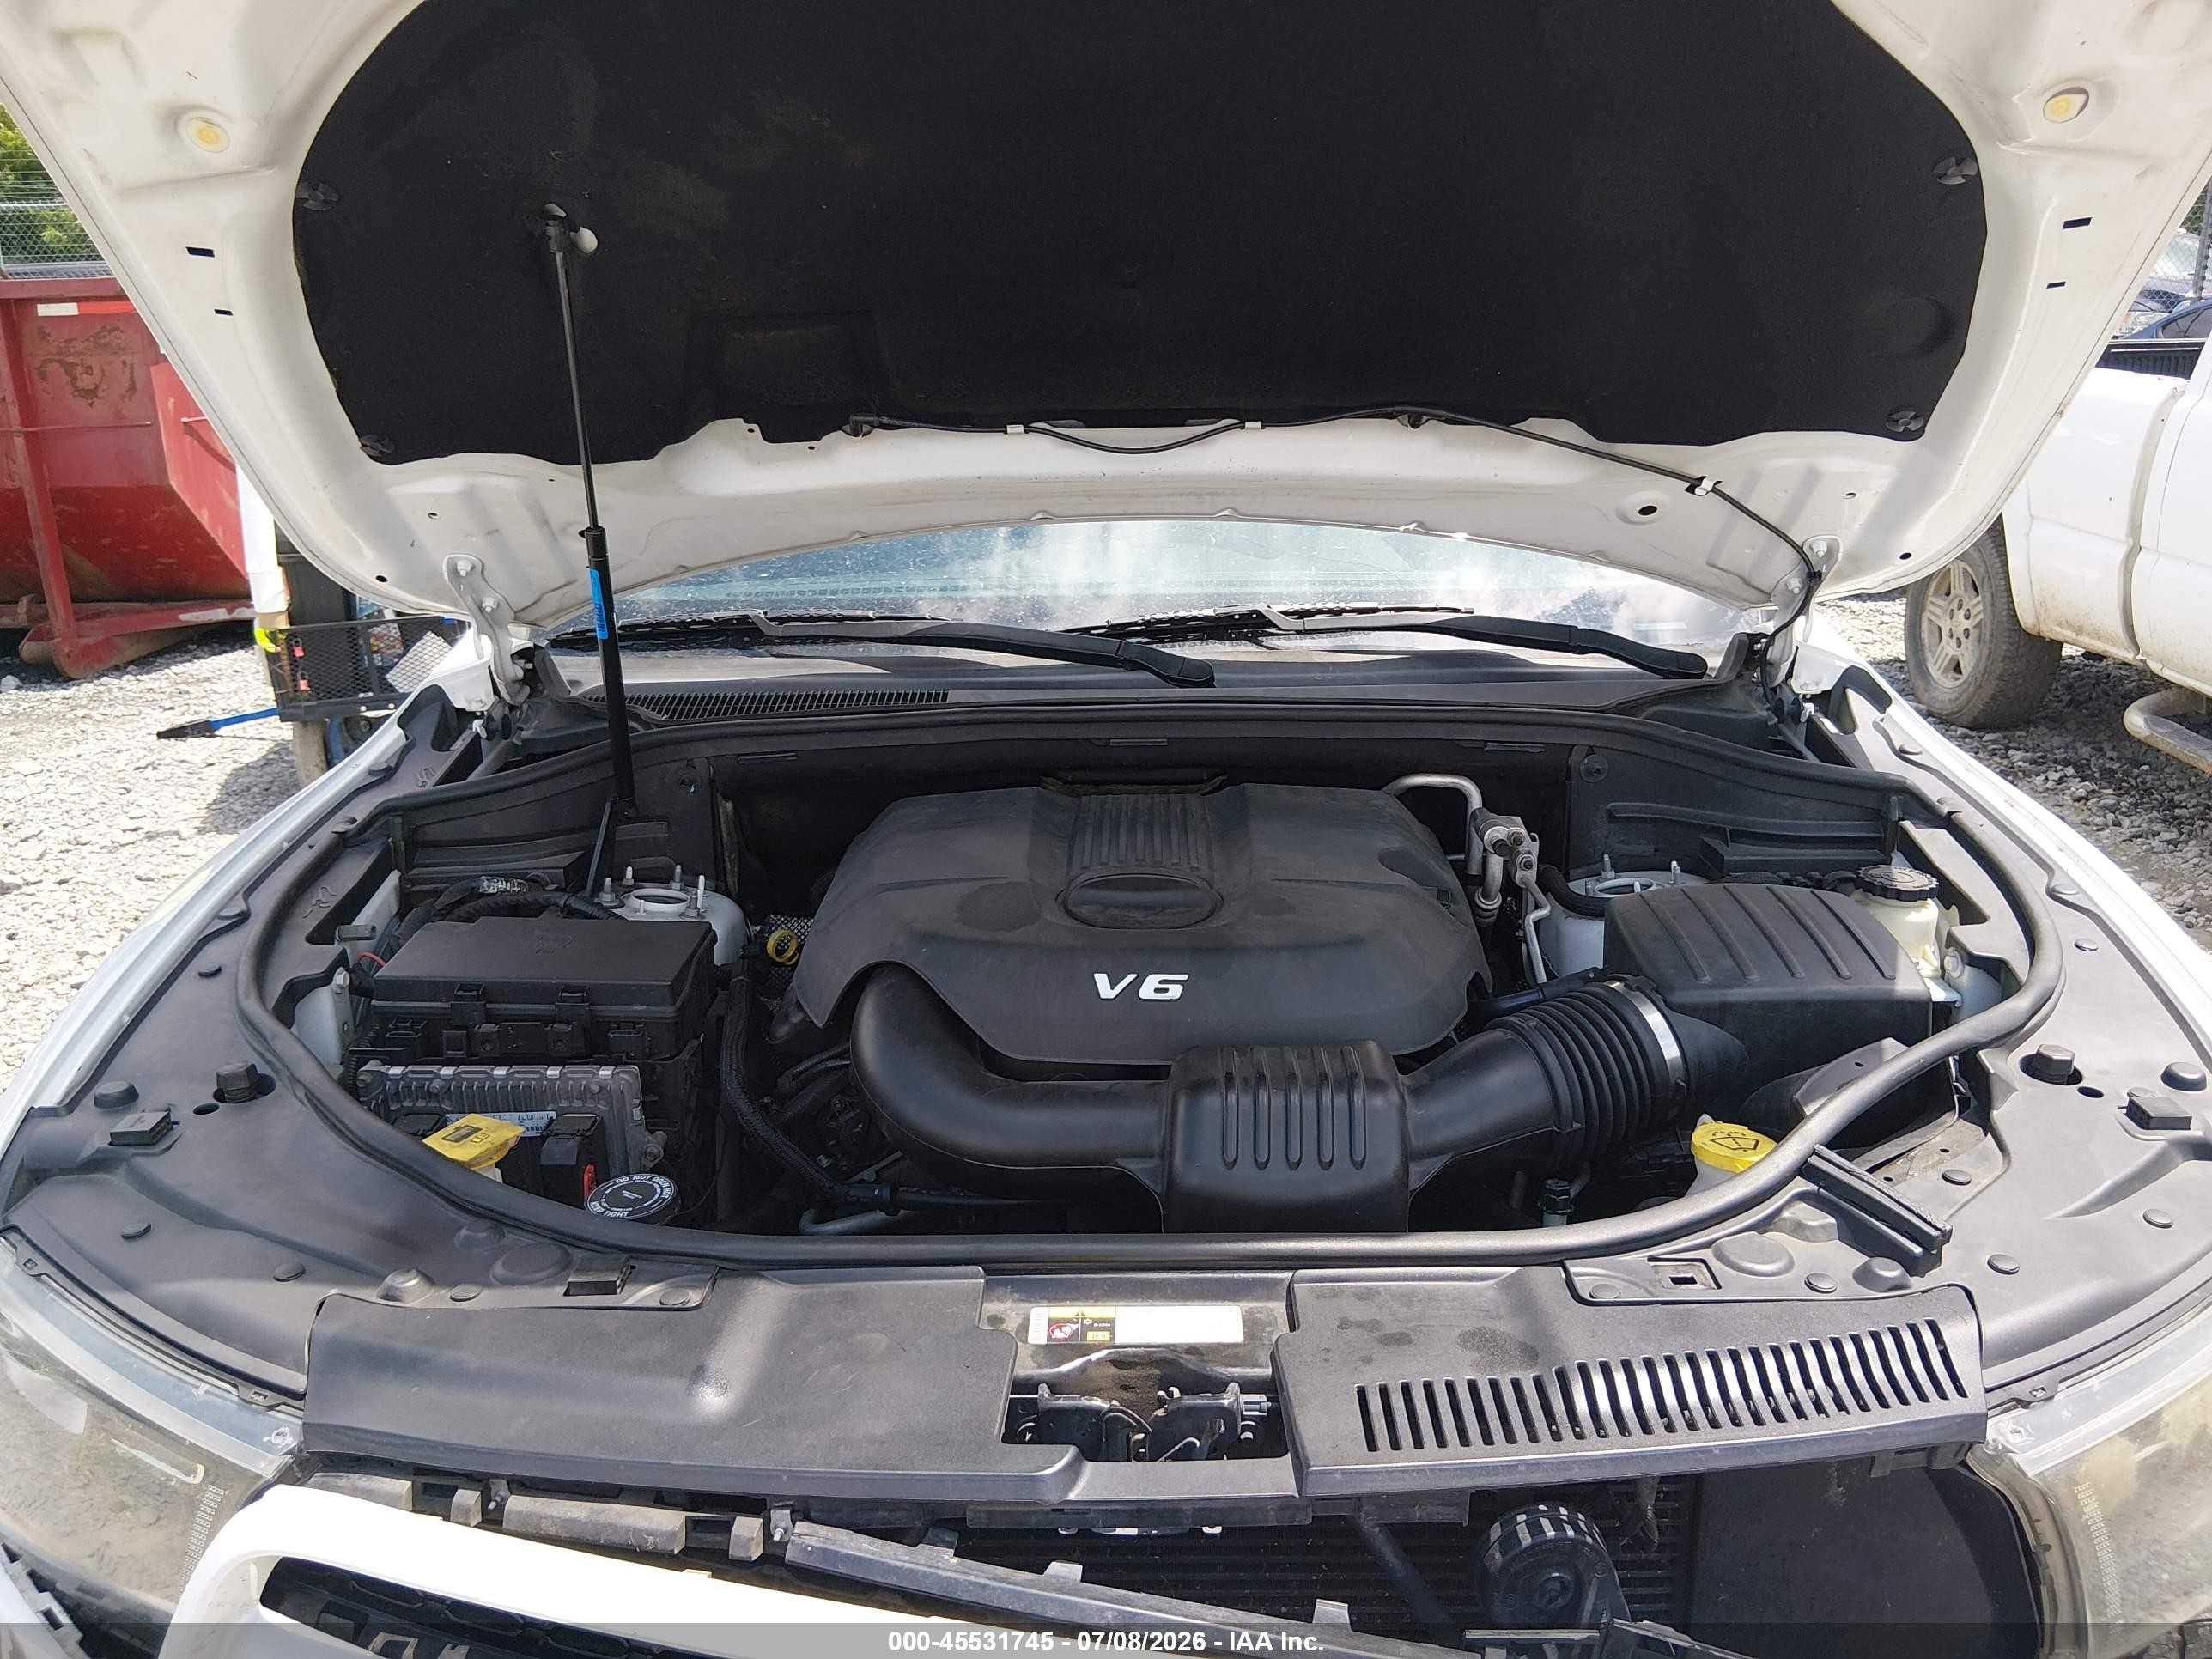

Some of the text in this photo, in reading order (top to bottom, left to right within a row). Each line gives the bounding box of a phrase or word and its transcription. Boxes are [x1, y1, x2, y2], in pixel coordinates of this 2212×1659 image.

[1093, 972, 1189, 1001] V6
[652, 1176, 671, 1188] OPEN
[660, 1187, 672, 1199] HOT
[590, 1200, 605, 1212] KEEP
